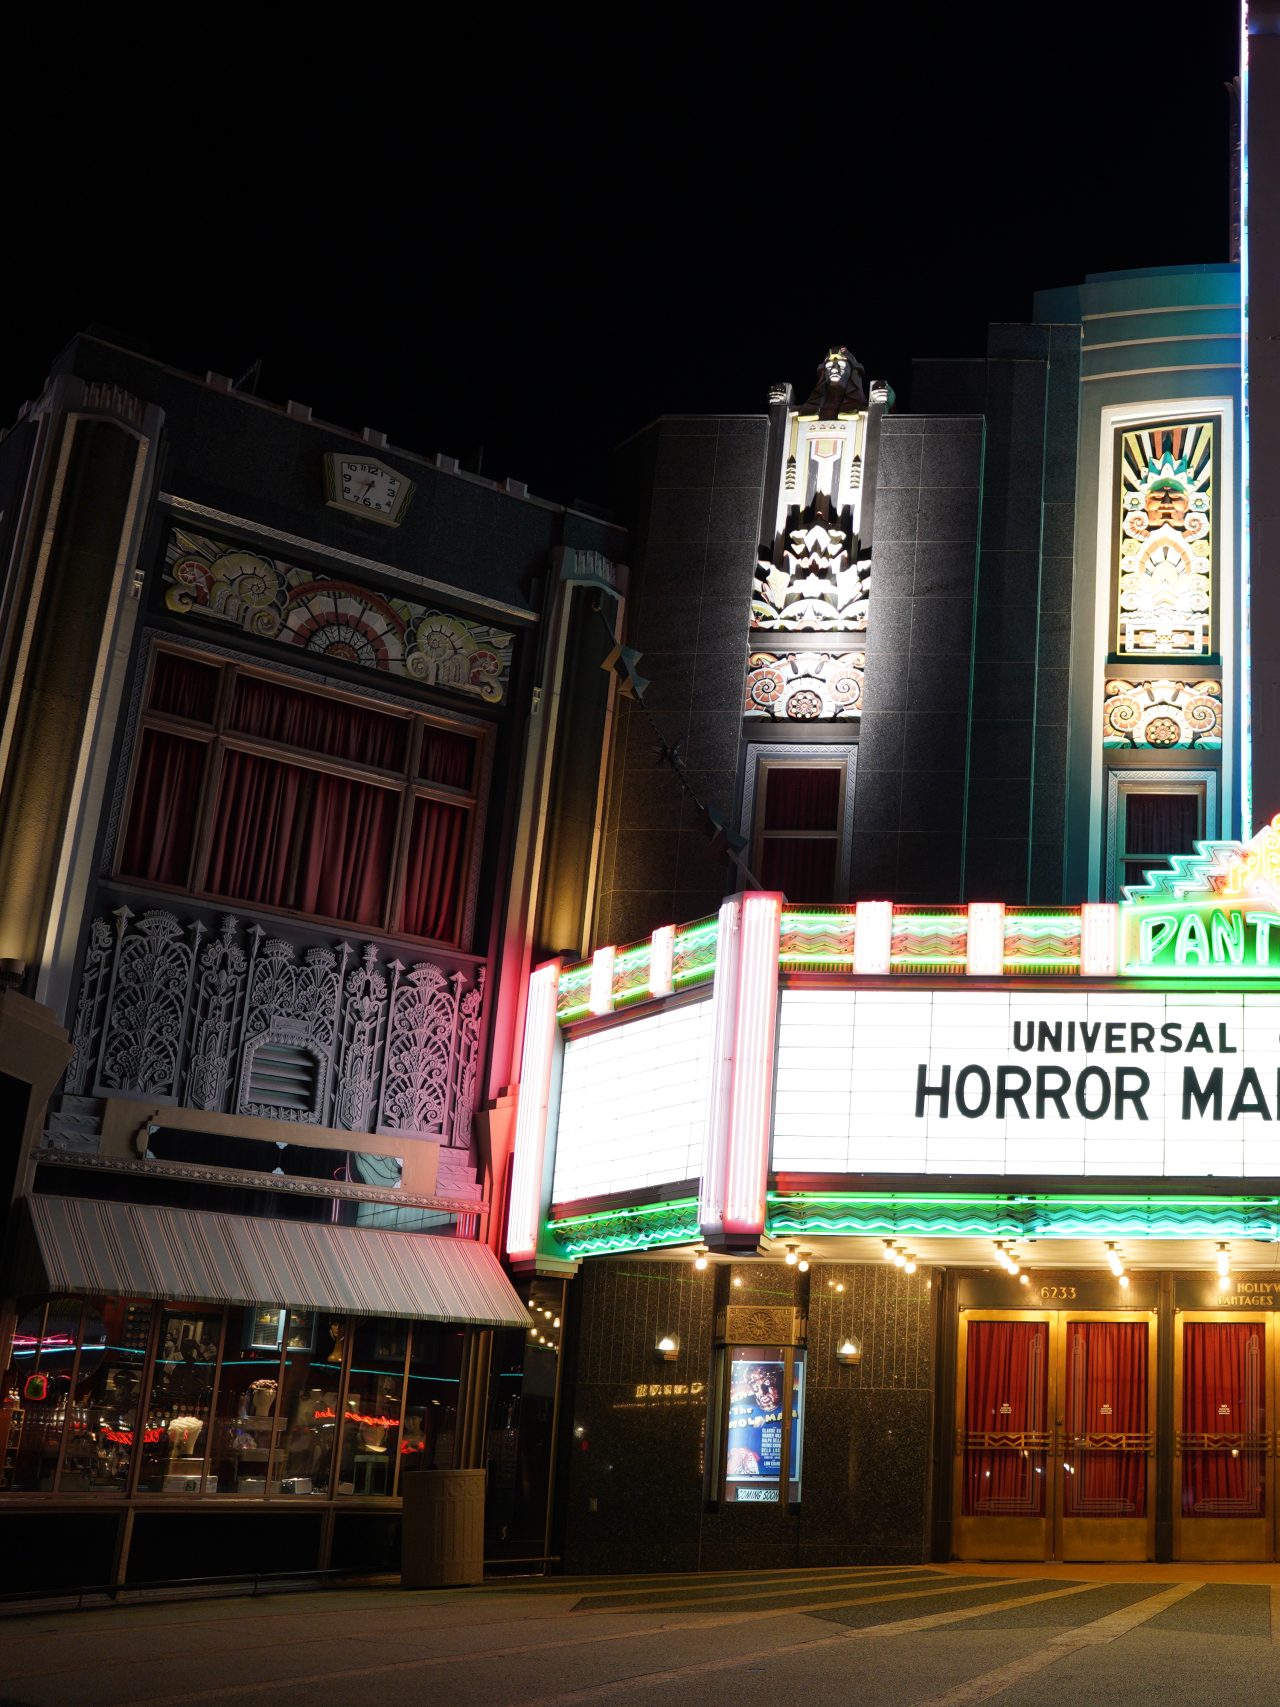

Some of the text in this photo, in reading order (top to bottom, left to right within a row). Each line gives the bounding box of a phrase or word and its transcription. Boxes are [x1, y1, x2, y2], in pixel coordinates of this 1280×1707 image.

[348, 464, 357, 472] 10
[368, 465, 378, 475] 12
[344, 474, 352, 482] 9
[387, 488, 395, 498] 3
[363, 498, 371, 507] 6
[1014, 1021, 1236, 1053] UNIVERSAL
[916, 1065, 1149, 1120] HORROR
[1040, 1286, 1077, 1299] 6233
[1217, 1295, 1273, 1306] PANTAGES
[738, 1490, 779, 1500] COMING SOON
